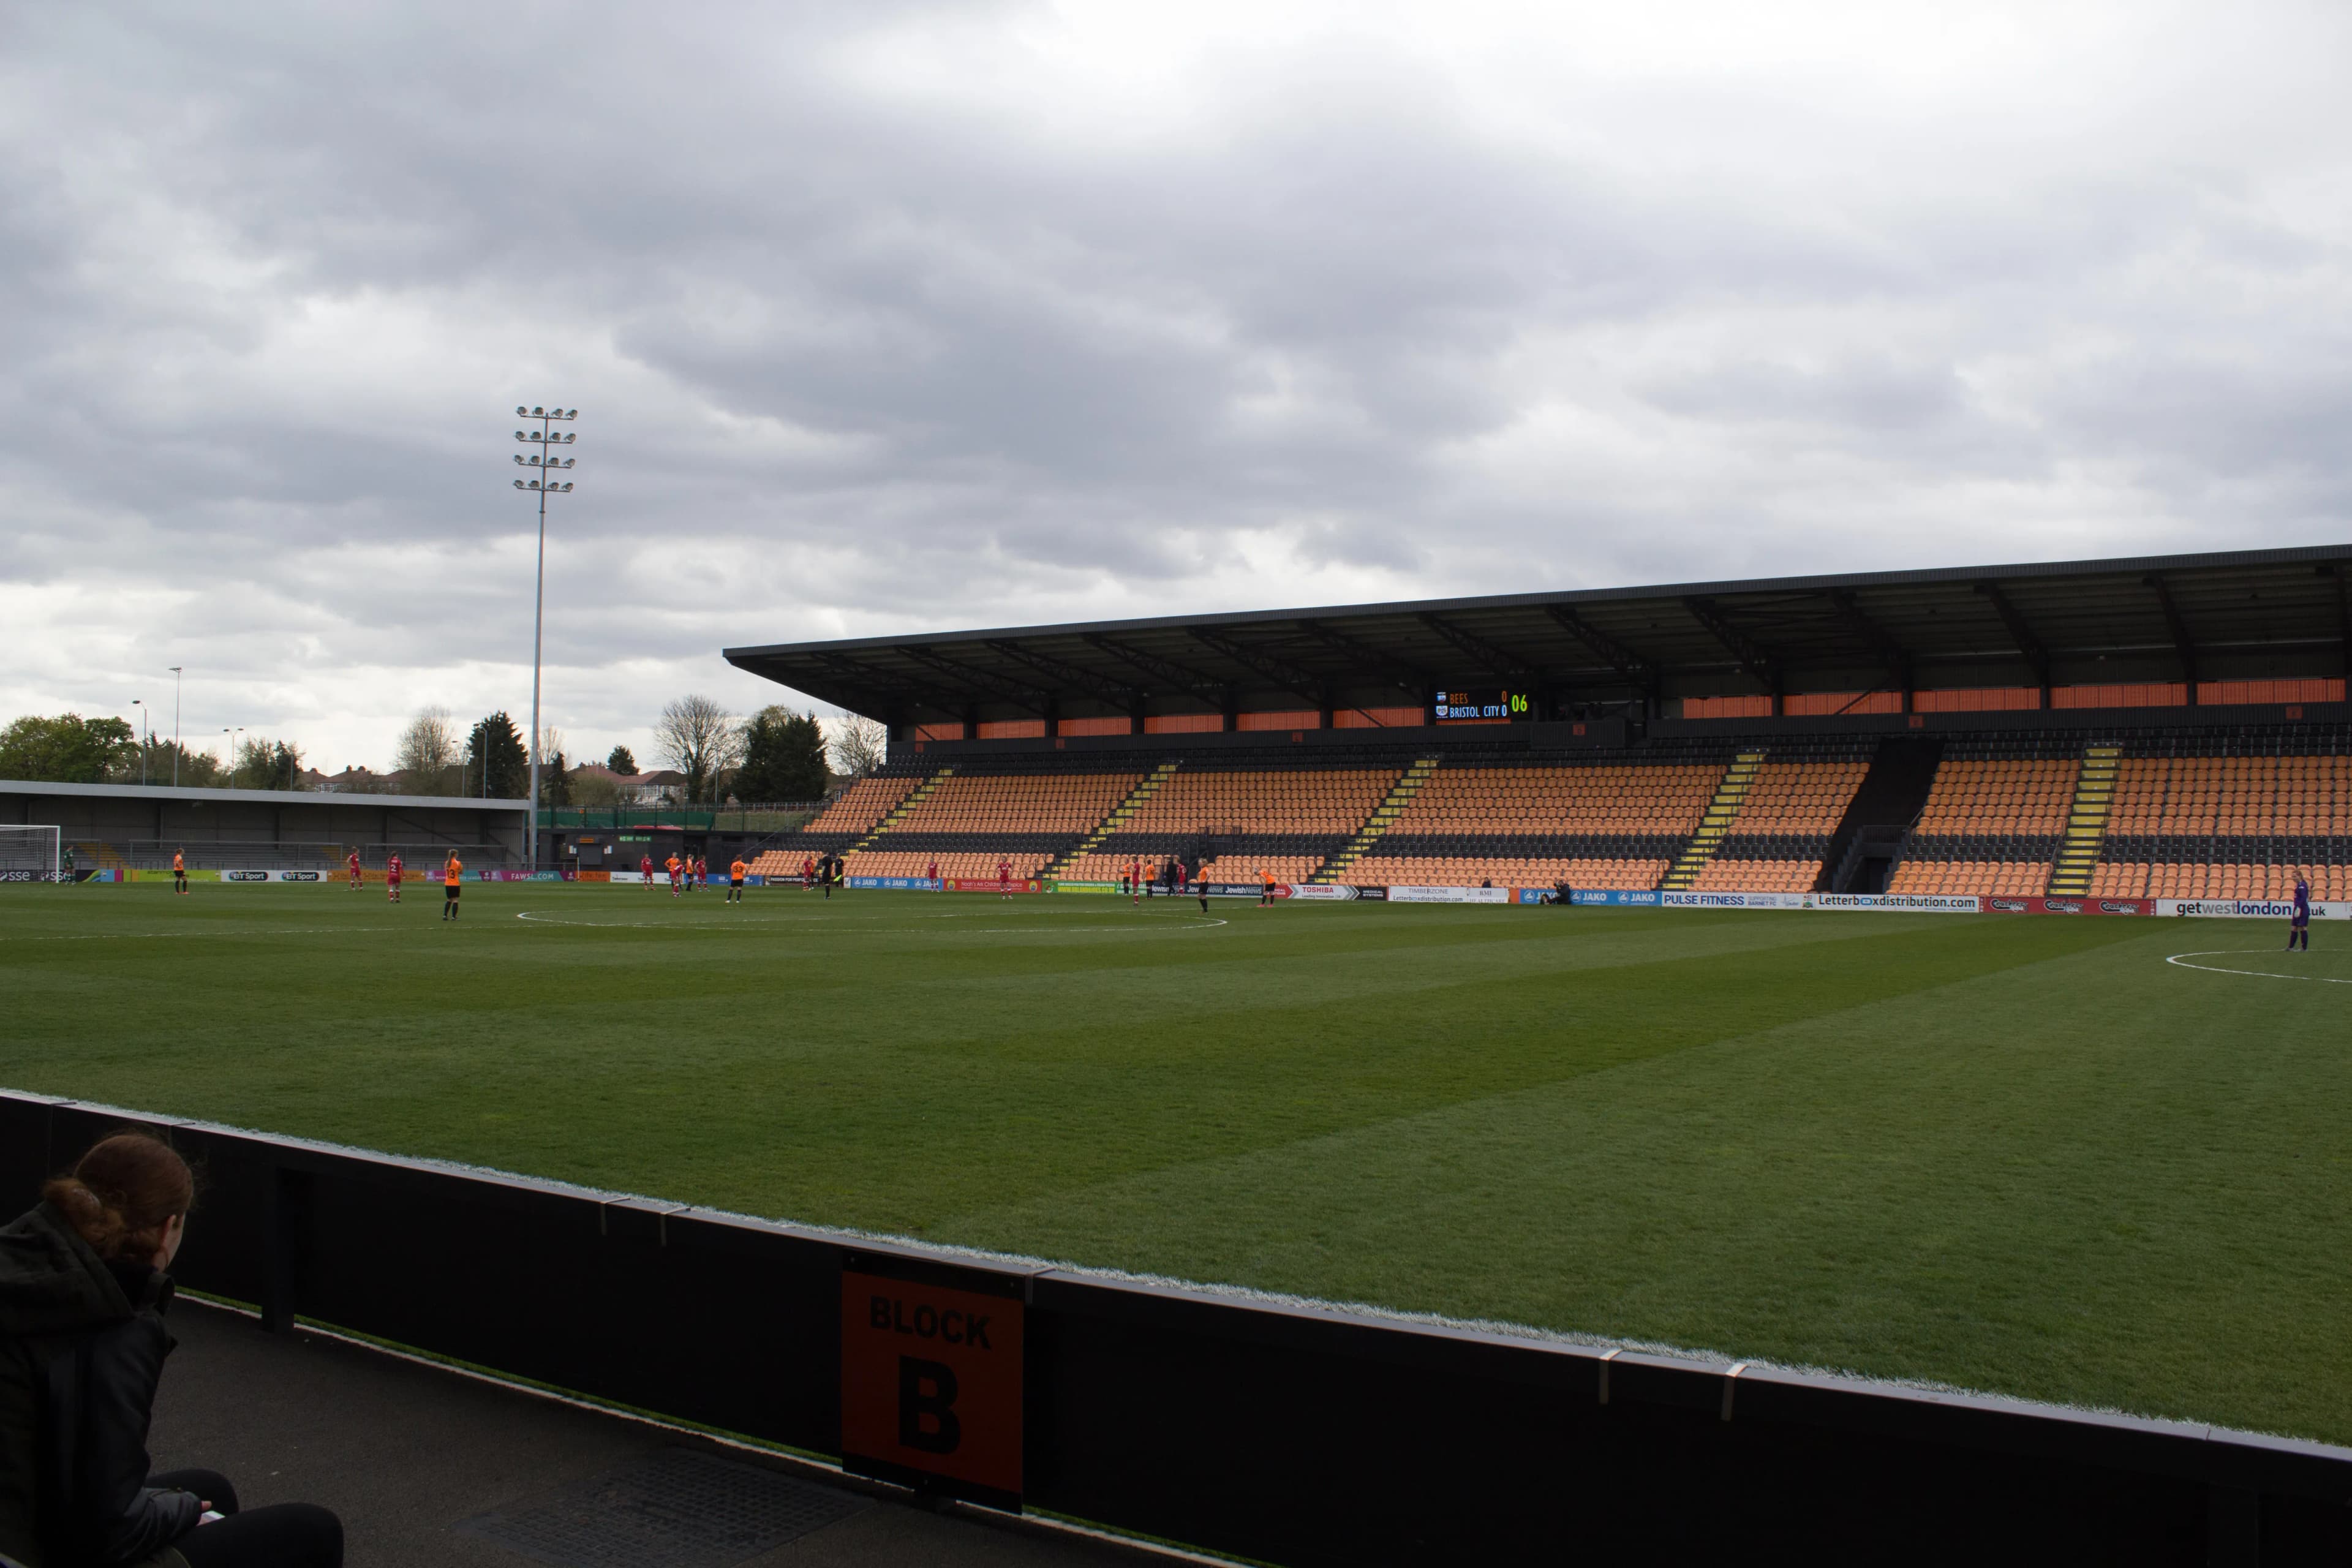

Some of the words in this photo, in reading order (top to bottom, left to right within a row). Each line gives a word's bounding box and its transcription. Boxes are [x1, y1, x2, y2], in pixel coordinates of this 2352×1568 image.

[1450, 693, 1468, 704] BEES
[1501, 691, 1507, 703] 0
[1511, 695, 1528, 712] 06
[1450, 706, 1480, 717] BRISTOL
[1483, 706, 1499, 717] CITY
[1501, 705, 1507, 717] 0
[9, 871, 30, 881] sse
[245, 872, 265, 881] Sport
[296, 872, 316, 881] Sport
[446, 869, 455, 879] 13
[1583, 892, 1607, 901] JAKO
[1630, 893, 1655, 902] JAKO
[1664, 895, 1698, 905] PULSE
[1700, 895, 1744, 905] FITNESS
[870, 1294, 992, 1351] BLOCK
[899, 1354, 961, 1455] B
